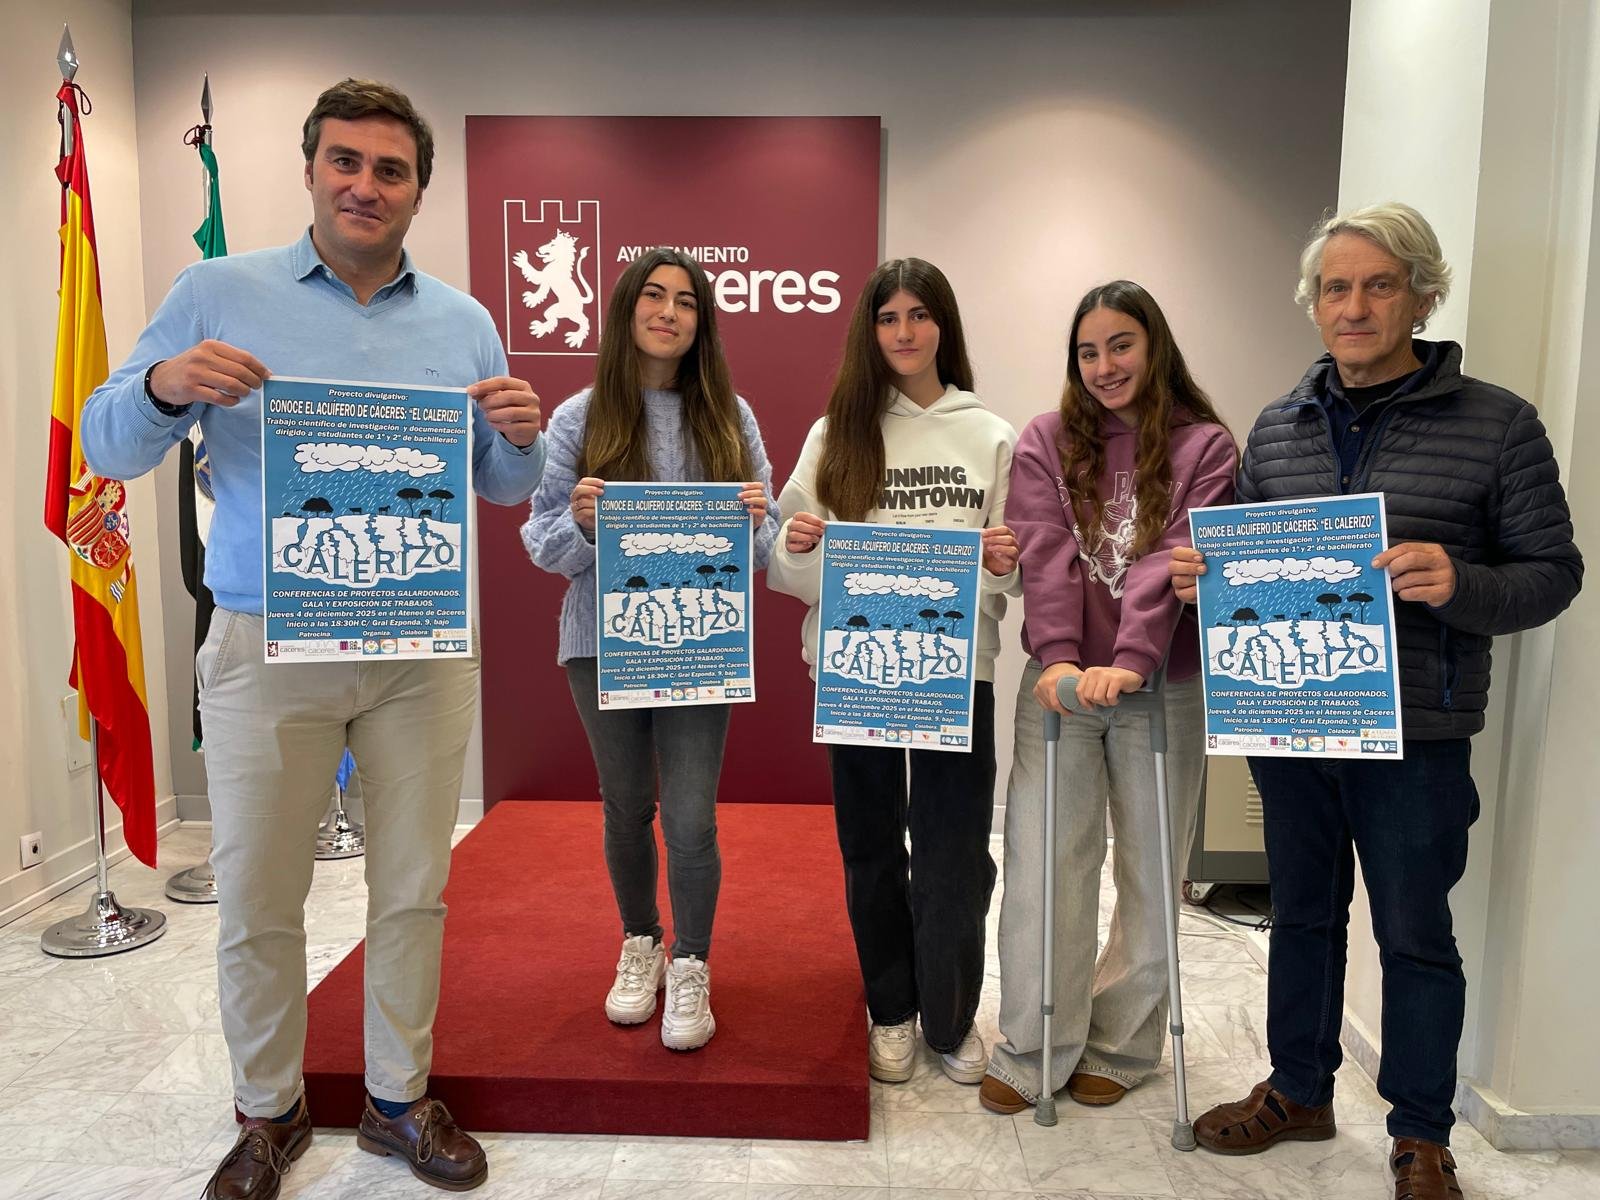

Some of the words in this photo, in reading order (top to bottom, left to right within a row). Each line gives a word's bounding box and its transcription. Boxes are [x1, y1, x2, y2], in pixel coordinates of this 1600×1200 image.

[703, 269, 842, 314] eres
[328, 389, 362, 398] Proyecto
[364, 391, 408, 401] divulgativo:
[270, 398, 303, 414] CONOCE
[305, 400, 314, 414] EL
[357, 404, 368, 417] DE
[370, 401, 406, 419] CÁCERES:
[266, 417, 296, 426] Trabajo
[349, 422, 399, 431] investigación
[409, 425, 465, 434] documentación
[275, 428, 305, 436] dirigido
[317, 430, 362, 438] estudiantes
[413, 435, 457, 443] bachillerato
[883, 466, 966, 488] UNNING
[601, 500, 626, 510] CONOCE
[627, 500, 634, 510] EL
[666, 500, 674, 510] DE
[715, 500, 743, 510] CALERIZO
[876, 487, 985, 510] WNTOWN
[1246, 510, 1276, 518] Proyecto
[1278, 506, 1319, 516] divulgativo:
[1198, 525, 1226, 538] CONOCE
[1227, 524, 1235, 536] EL
[1272, 521, 1283, 533] DE
[1284, 515, 1319, 532] CÁCERES:
[828, 538, 852, 550] CONOCE
[853, 540, 860, 550] EL
[891, 542, 900, 552] DE
[1196, 541, 1220, 549] Trabajo
[1266, 535, 1313, 545] investigación
[1322, 531, 1380, 540] documentación
[1327, 541, 1372, 549] bachillerato
[283, 541, 454, 583] CALERIZO
[332, 599, 379, 607] EXPOSICIÓN
[612, 608, 739, 645] CALERIZO
[830, 648, 962, 687] CALERIZO
[1217, 644, 1379, 684] CALERIZO
[1262, 698, 1305, 706] EXPOSICIÓN
